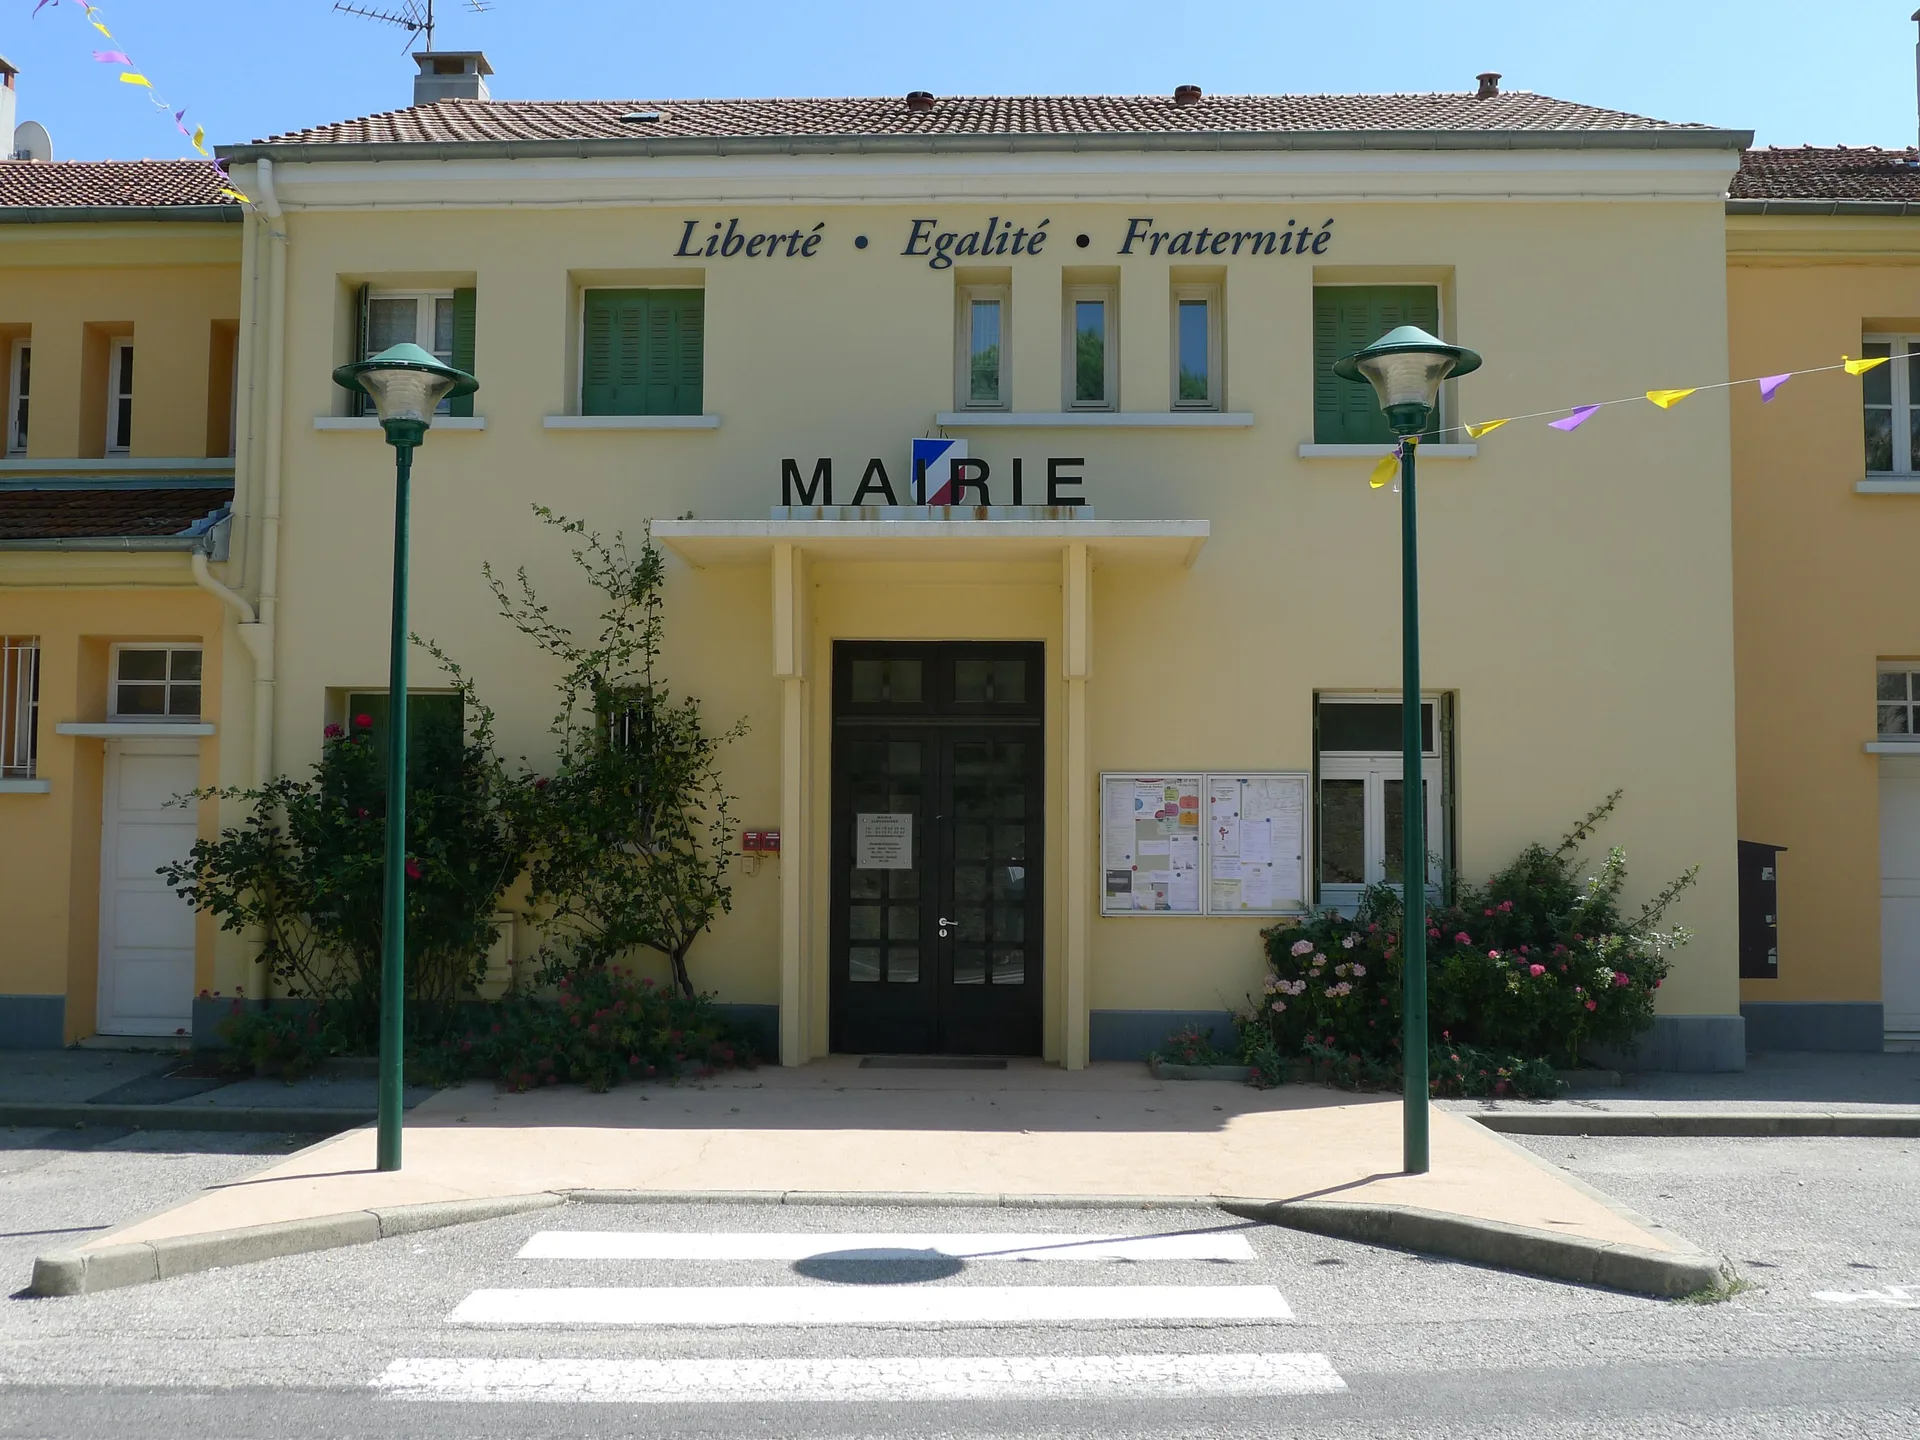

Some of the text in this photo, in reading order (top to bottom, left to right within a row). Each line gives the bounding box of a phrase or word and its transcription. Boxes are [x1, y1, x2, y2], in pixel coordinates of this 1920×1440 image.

[673, 216, 1334, 269] Liberté Egalité Fraternité
[781, 457, 1086, 506] MAIRIE
